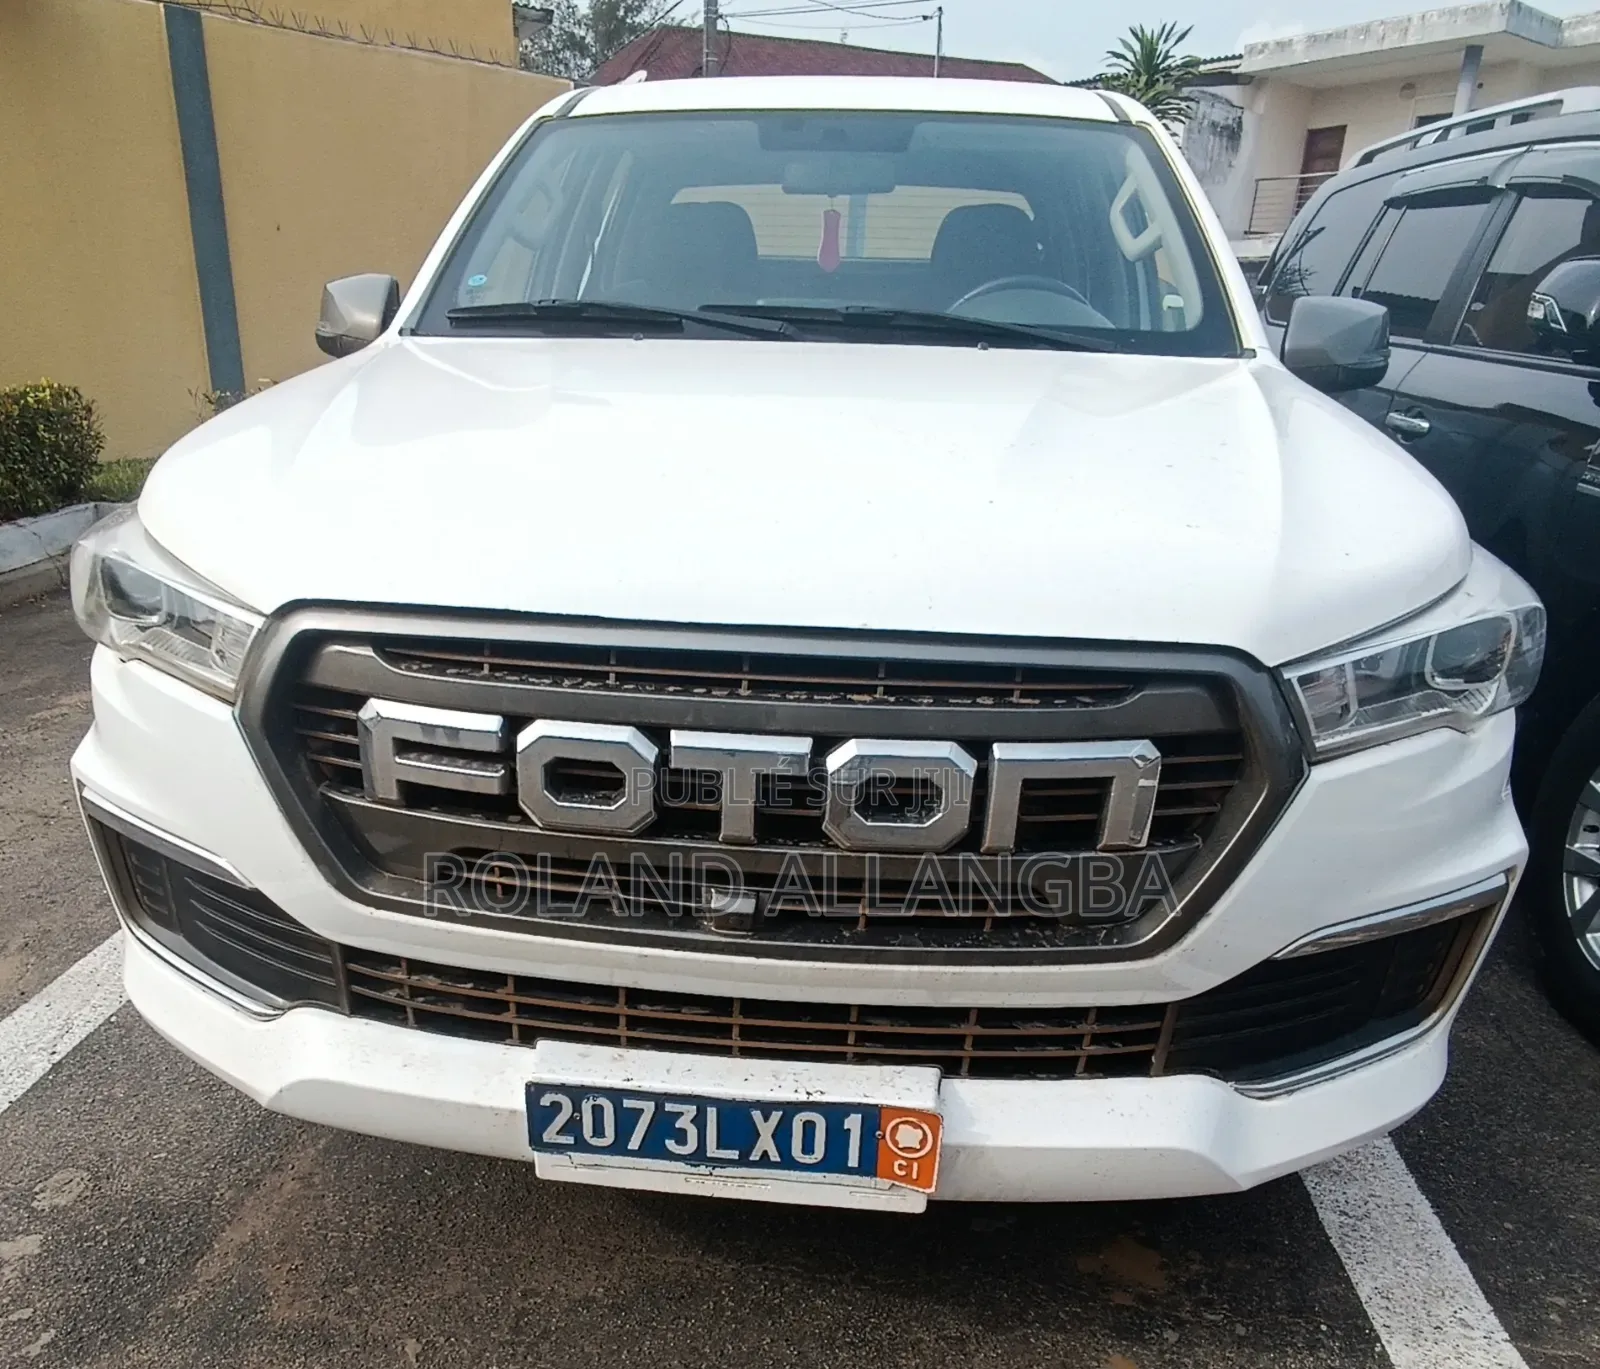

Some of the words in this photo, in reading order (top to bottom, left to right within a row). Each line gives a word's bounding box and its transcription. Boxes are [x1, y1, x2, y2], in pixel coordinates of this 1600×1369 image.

[357, 698, 1162, 855] FOTON
[539, 1092, 863, 1168] 2073LX01
[893, 1159, 918, 1180] CI
